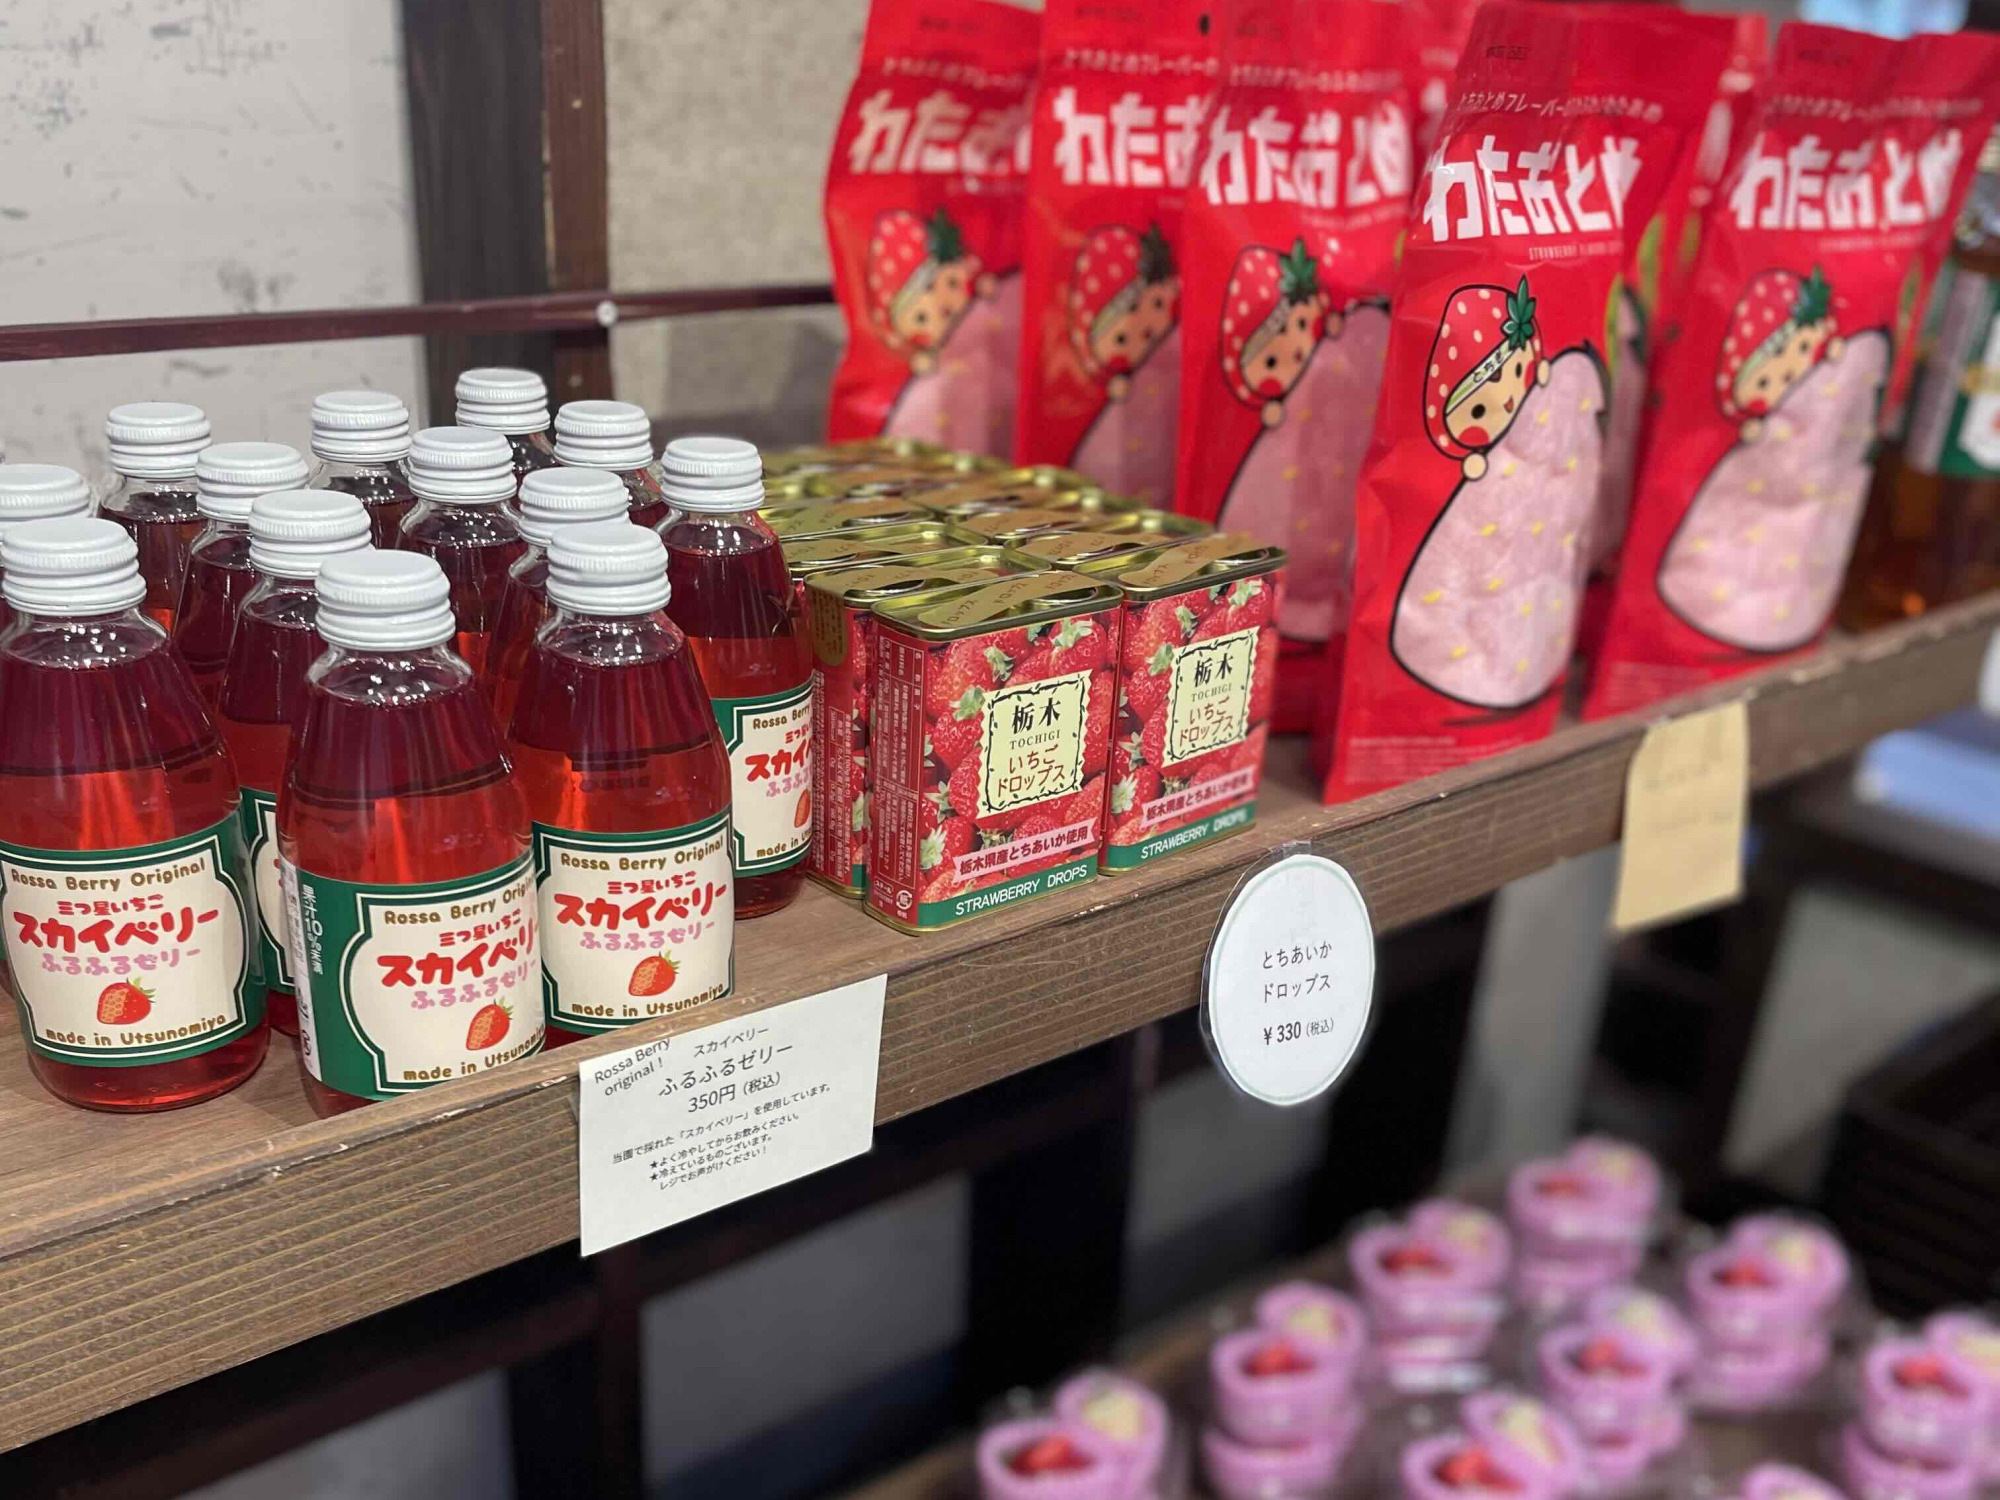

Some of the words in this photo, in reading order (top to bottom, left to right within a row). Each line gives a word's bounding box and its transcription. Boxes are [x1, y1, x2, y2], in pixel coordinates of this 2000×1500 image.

[1194, 653, 1235, 688] 栃木
[1190, 682, 1233, 704] TOCHIGI
[753, 714, 788, 730] Rossa
[1010, 697, 1062, 736] 栃木
[1189, 696, 1230, 724] いちご
[1009, 729, 1062, 751] TOCHIGI
[1179, 715, 1235, 748] ドロップス
[1008, 744, 1060, 773] いちご
[996, 764, 1067, 799] ドロップス
[561, 853, 610, 872] Rossa
[619, 855, 667, 872] Berry
[674, 835, 725, 864] Original
[756, 842, 787, 858] made
[790, 837, 799, 849] in
[958, 825, 1089, 876] 栃木県産とちあいか使用
[1140, 823, 1209, 859] STRAWBERRY
[11, 867, 58, 890] Rossa
[66, 876, 121, 892] Berry
[130, 857, 206, 888] Original
[607, 870, 697, 896] 三つ星いちご
[955, 879, 1041, 916] STRAWBERRY
[1047, 864, 1088, 888] DROPS
[56, 894, 165, 917] 三つ星いちご
[384, 910, 441, 926] Rossa
[449, 898, 498, 921] Berry
[553, 882, 728, 931] スカイベリー
[13, 906, 220, 953] スカイベリー
[439, 908, 522, 948] 三つ星いちご
[1262, 940, 1333, 970] とちあいか
[571, 1003, 614, 1018] made
[622, 1003, 638, 1018] in
[646, 982, 726, 1016] Utsunomiya
[1264, 973, 1332, 1003] ドロップス
[45, 1027, 86, 1046] made
[94, 1032, 112, 1047] in
[120, 1013, 227, 1047] Utsunomiya
[692, 1027, 770, 1060] スカイベリー
[402, 1065, 453, 1082] made
[460, 1061, 478, 1076] in
[593, 1058, 634, 1085] Rossa
[634, 1037, 672, 1064] Berry
[657, 1044, 794, 1098] ふるふるゼリー
[687, 1083, 737, 1115] 350円
